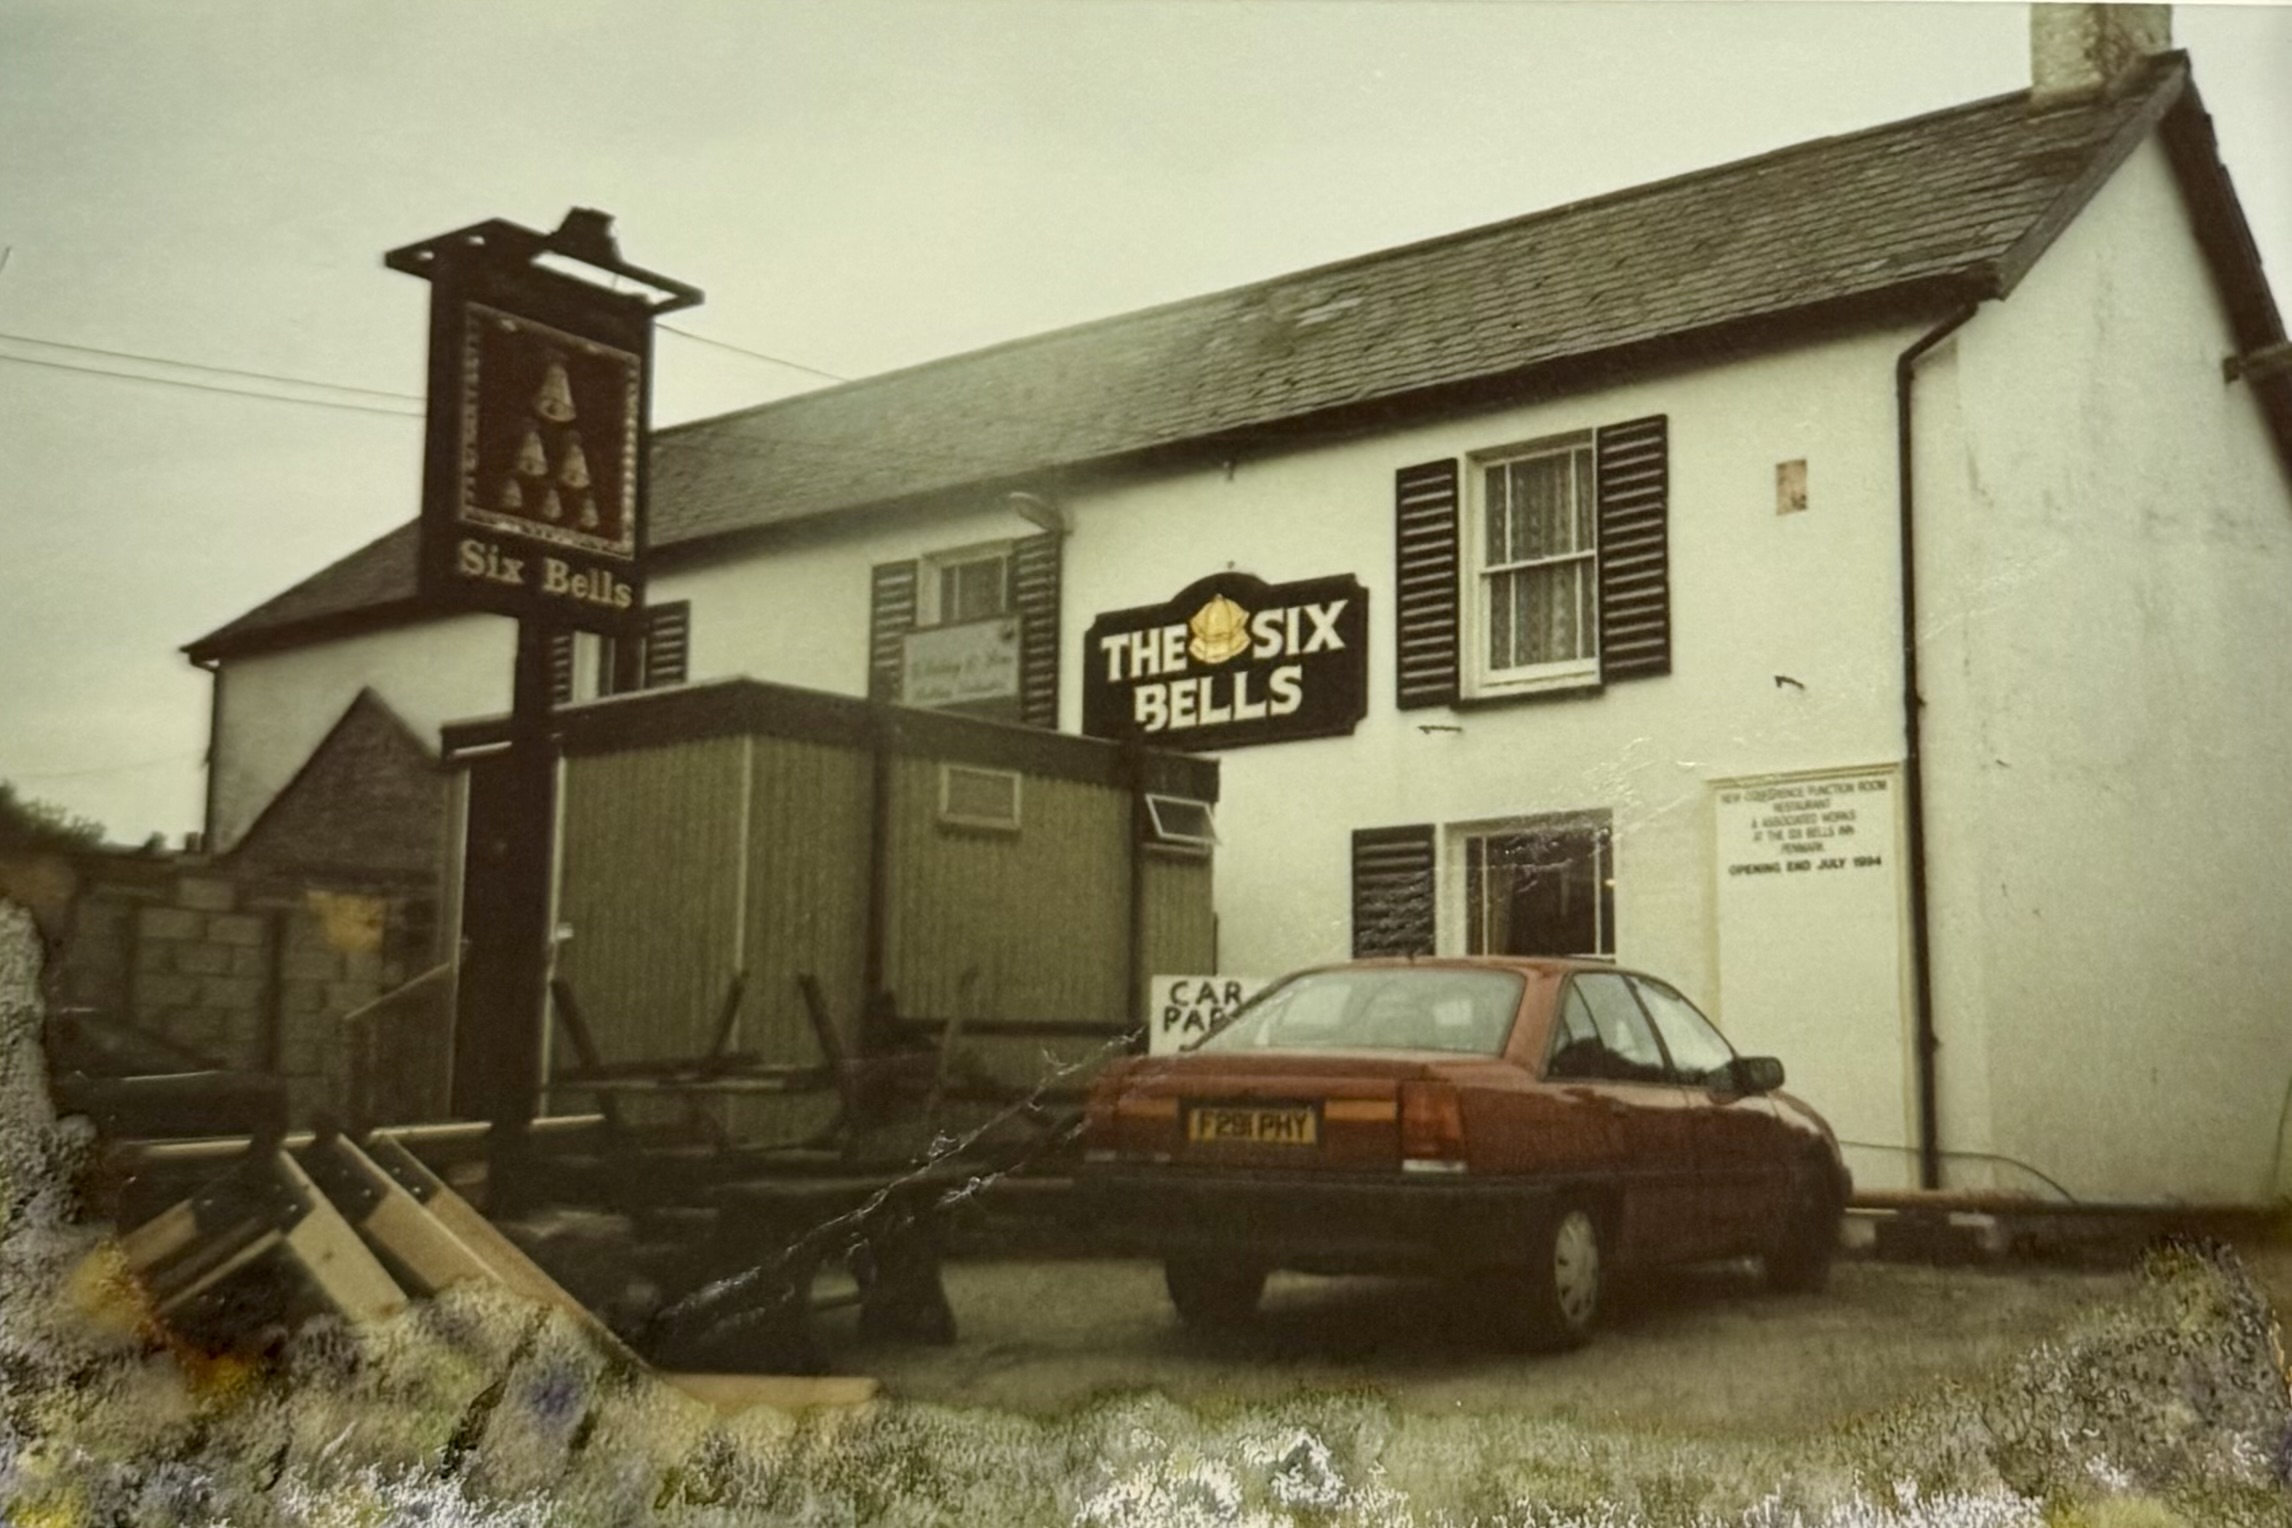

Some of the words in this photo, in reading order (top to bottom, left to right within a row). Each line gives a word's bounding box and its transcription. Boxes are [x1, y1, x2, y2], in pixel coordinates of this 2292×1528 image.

[459, 539, 524, 584] Six
[542, 557, 632, 608] Bells
[1101, 623, 1188, 682] THE
[1251, 599, 1348, 659] SIX
[1133, 665, 1303, 732] BELLS
[1807, 783, 1854, 796] FUNCTION
[1857, 780, 1887, 792] ROOM
[1773, 799, 1831, 812] RESTAURANT
[1762, 813, 1817, 827] ASSOCIATED
[1821, 810, 1856, 822] WORKS
[1767, 829, 1783, 841] THE
[1788, 828, 1802, 840] SIX
[1806, 826, 1834, 838] BELLS
[1728, 862, 1781, 876] OPENING
[1786, 860, 1811, 872] END
[1817, 858, 1846, 870] JULY
[1169, 980, 1242, 1007] CAR
[1258, 1112, 1309, 1140] PHY
